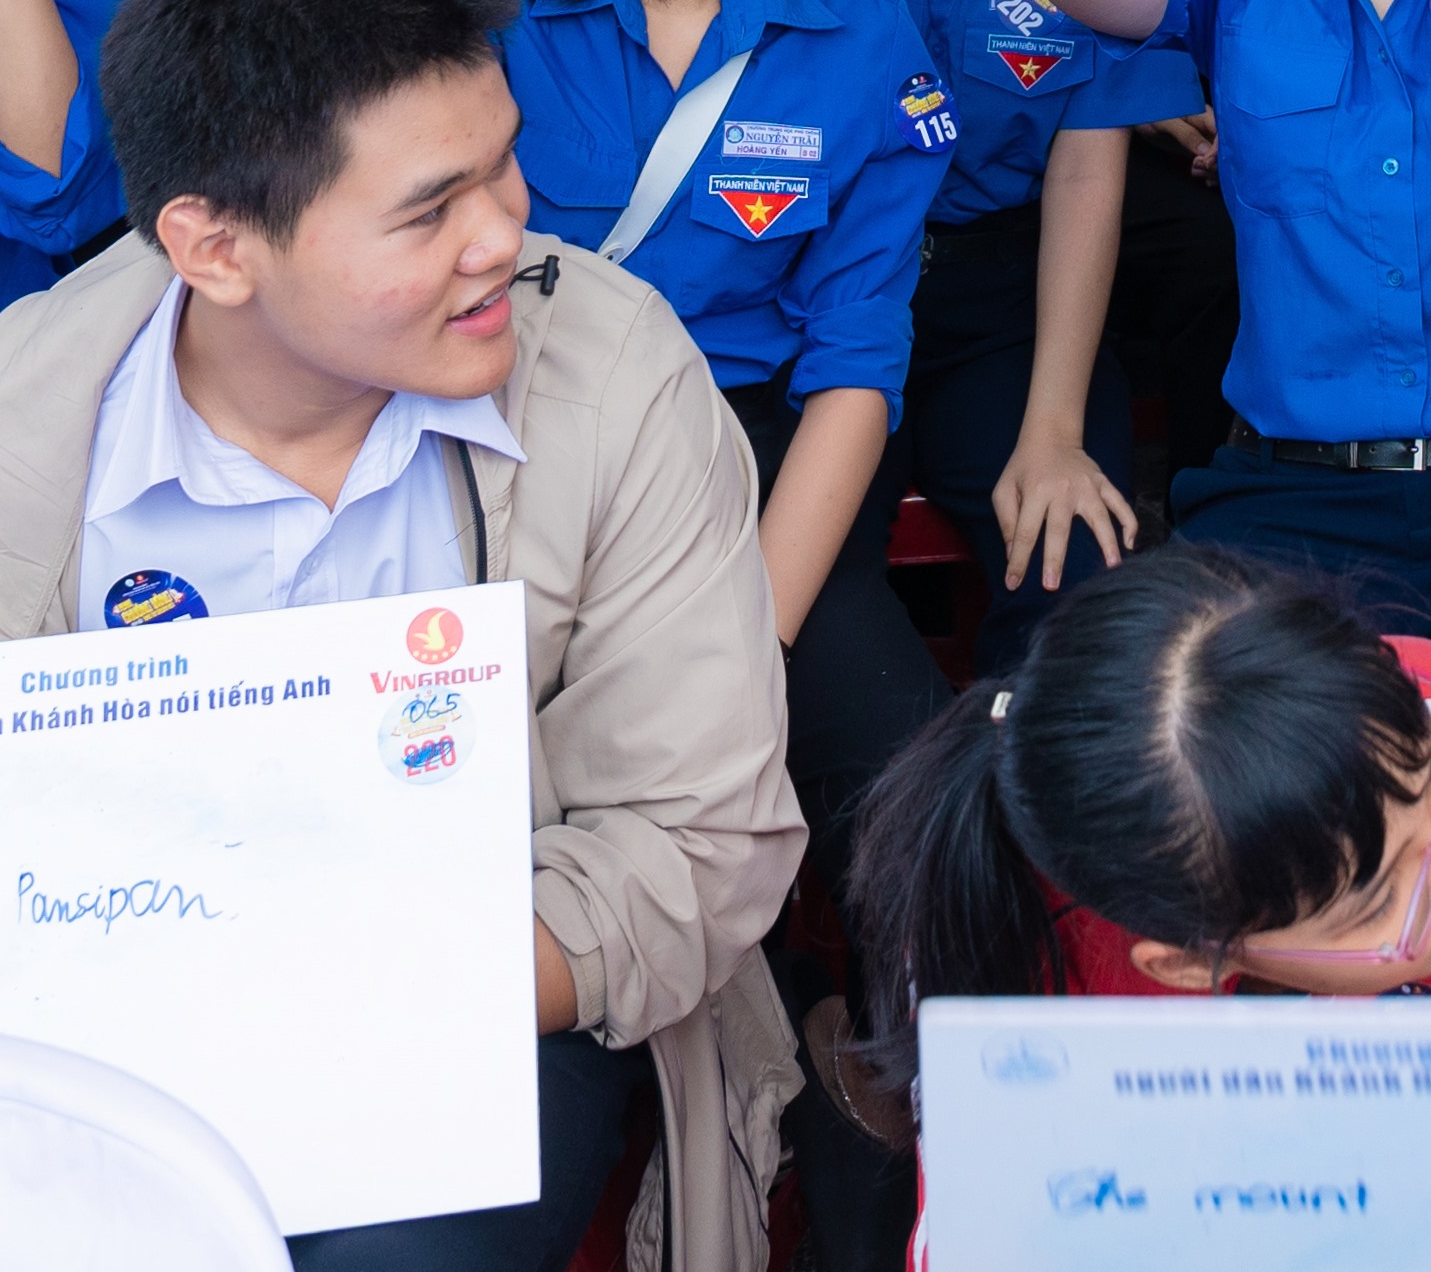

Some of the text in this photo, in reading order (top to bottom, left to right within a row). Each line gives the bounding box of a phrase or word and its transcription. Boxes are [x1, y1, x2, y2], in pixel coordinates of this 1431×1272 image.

[915, 112, 957, 147] 115
[714, 180, 745, 190] THANH
[370, 664, 501, 694] VINGROUP
